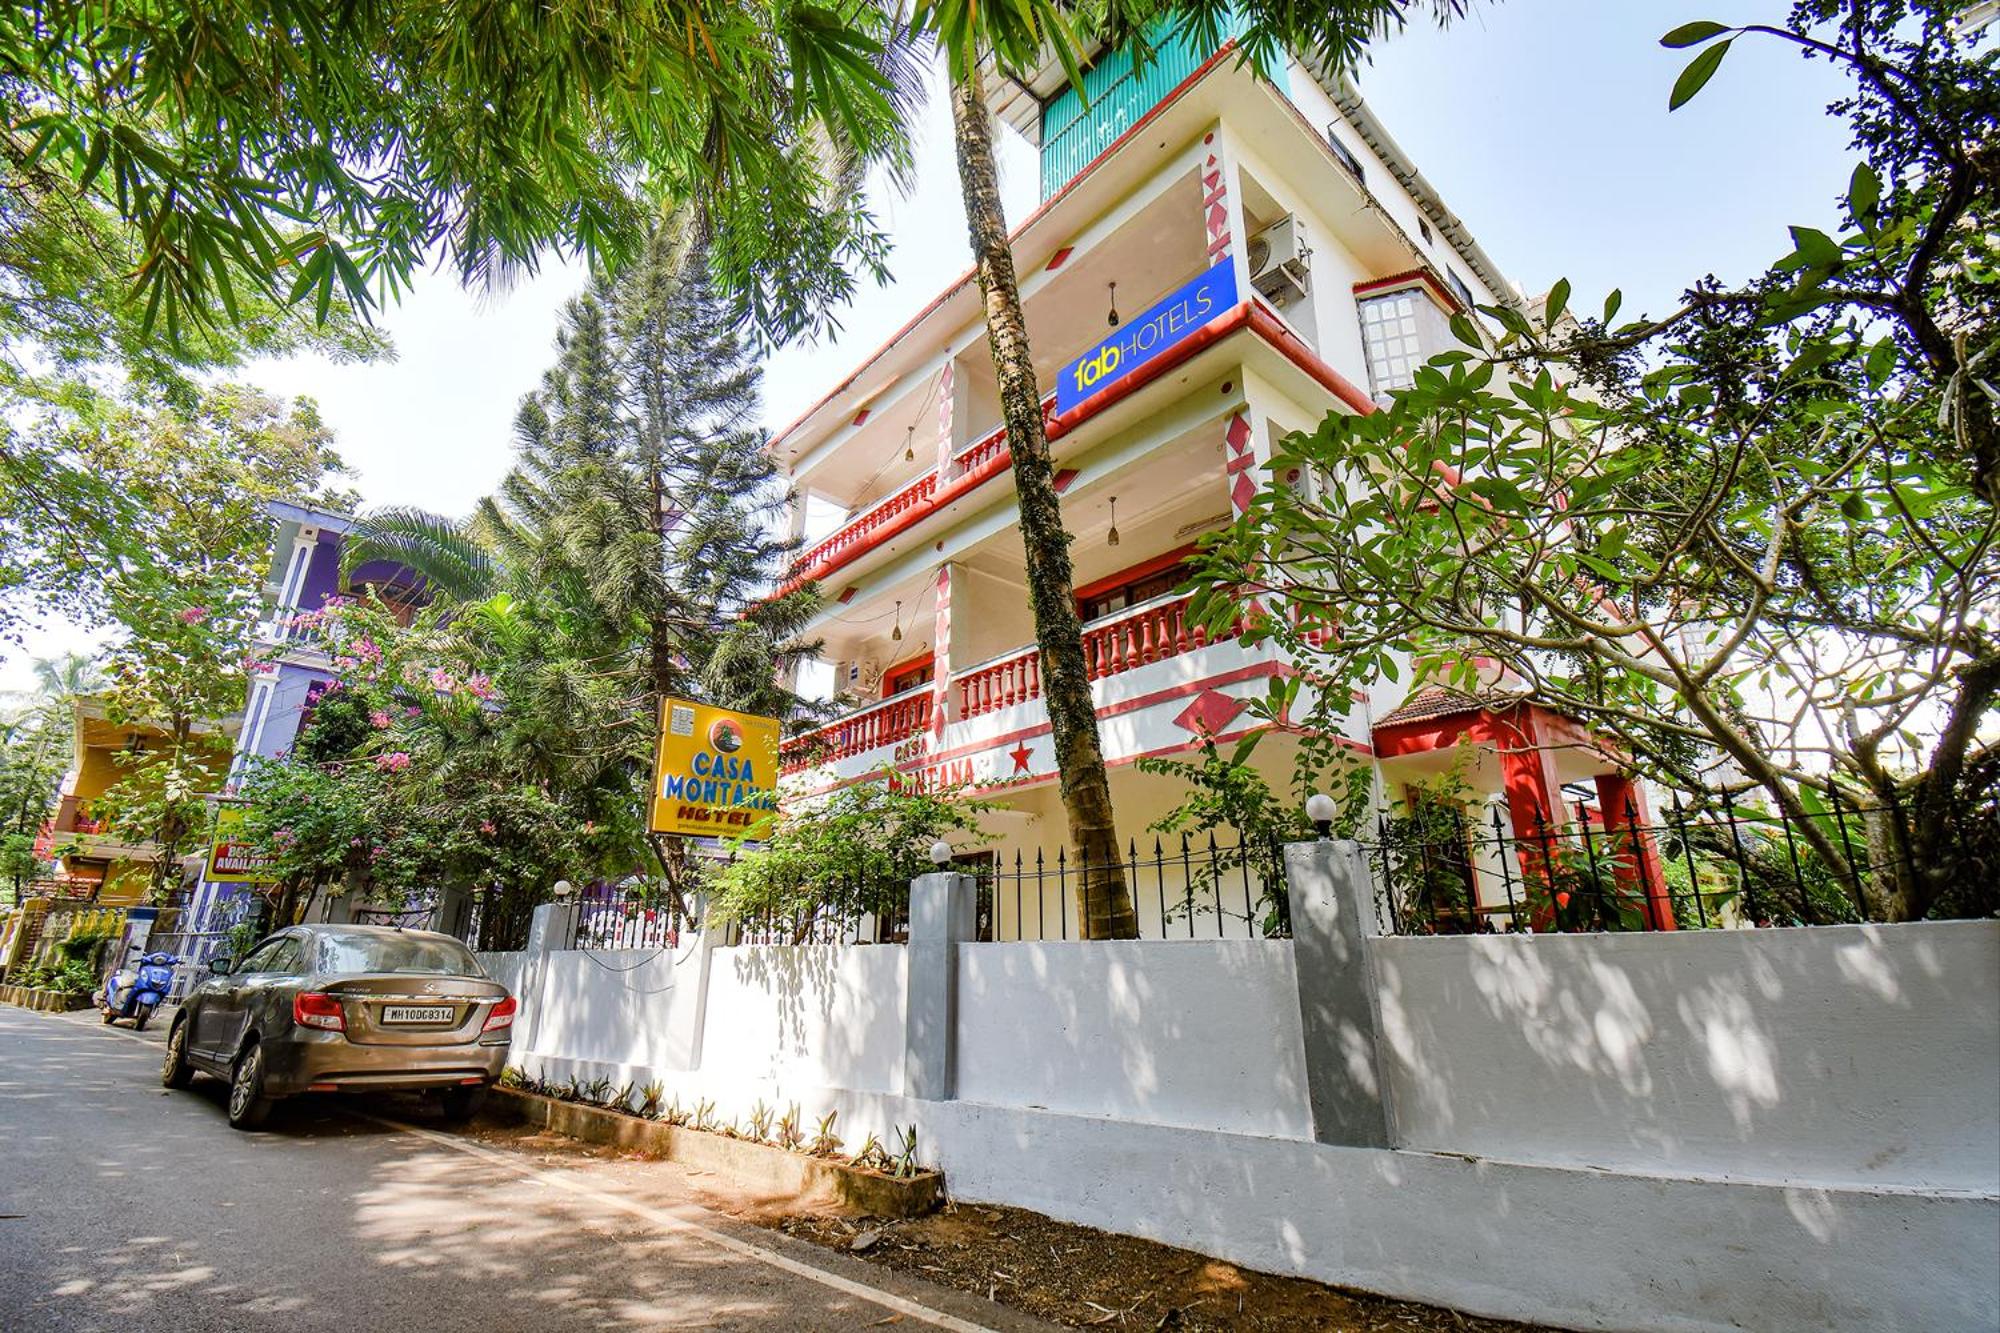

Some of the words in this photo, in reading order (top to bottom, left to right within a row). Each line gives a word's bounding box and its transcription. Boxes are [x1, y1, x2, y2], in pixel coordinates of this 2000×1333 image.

[1073, 286, 1213, 392] fabHOTELS
[894, 737, 928, 761] CASA
[692, 752, 754, 782] CASA
[677, 806, 753, 826] HOTEL
